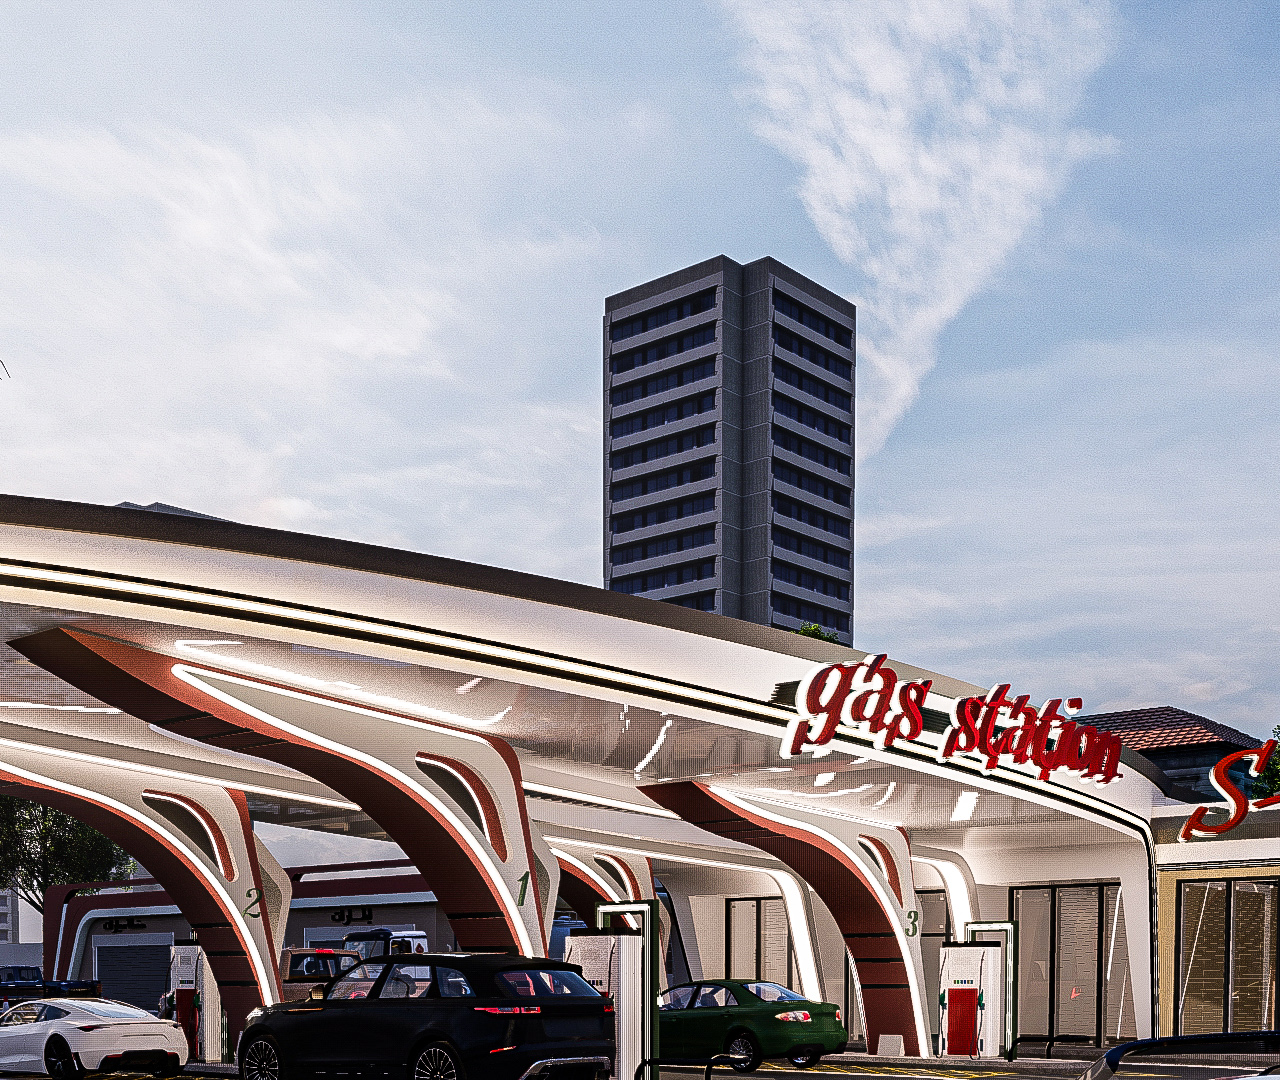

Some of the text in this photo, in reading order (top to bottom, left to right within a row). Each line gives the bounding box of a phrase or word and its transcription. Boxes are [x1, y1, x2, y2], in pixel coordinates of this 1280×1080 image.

[784, 653, 1124, 784] gas station
[242, 887, 263, 918] 2
[517, 870, 530, 907] 1
[904, 910, 919, 937] 3
